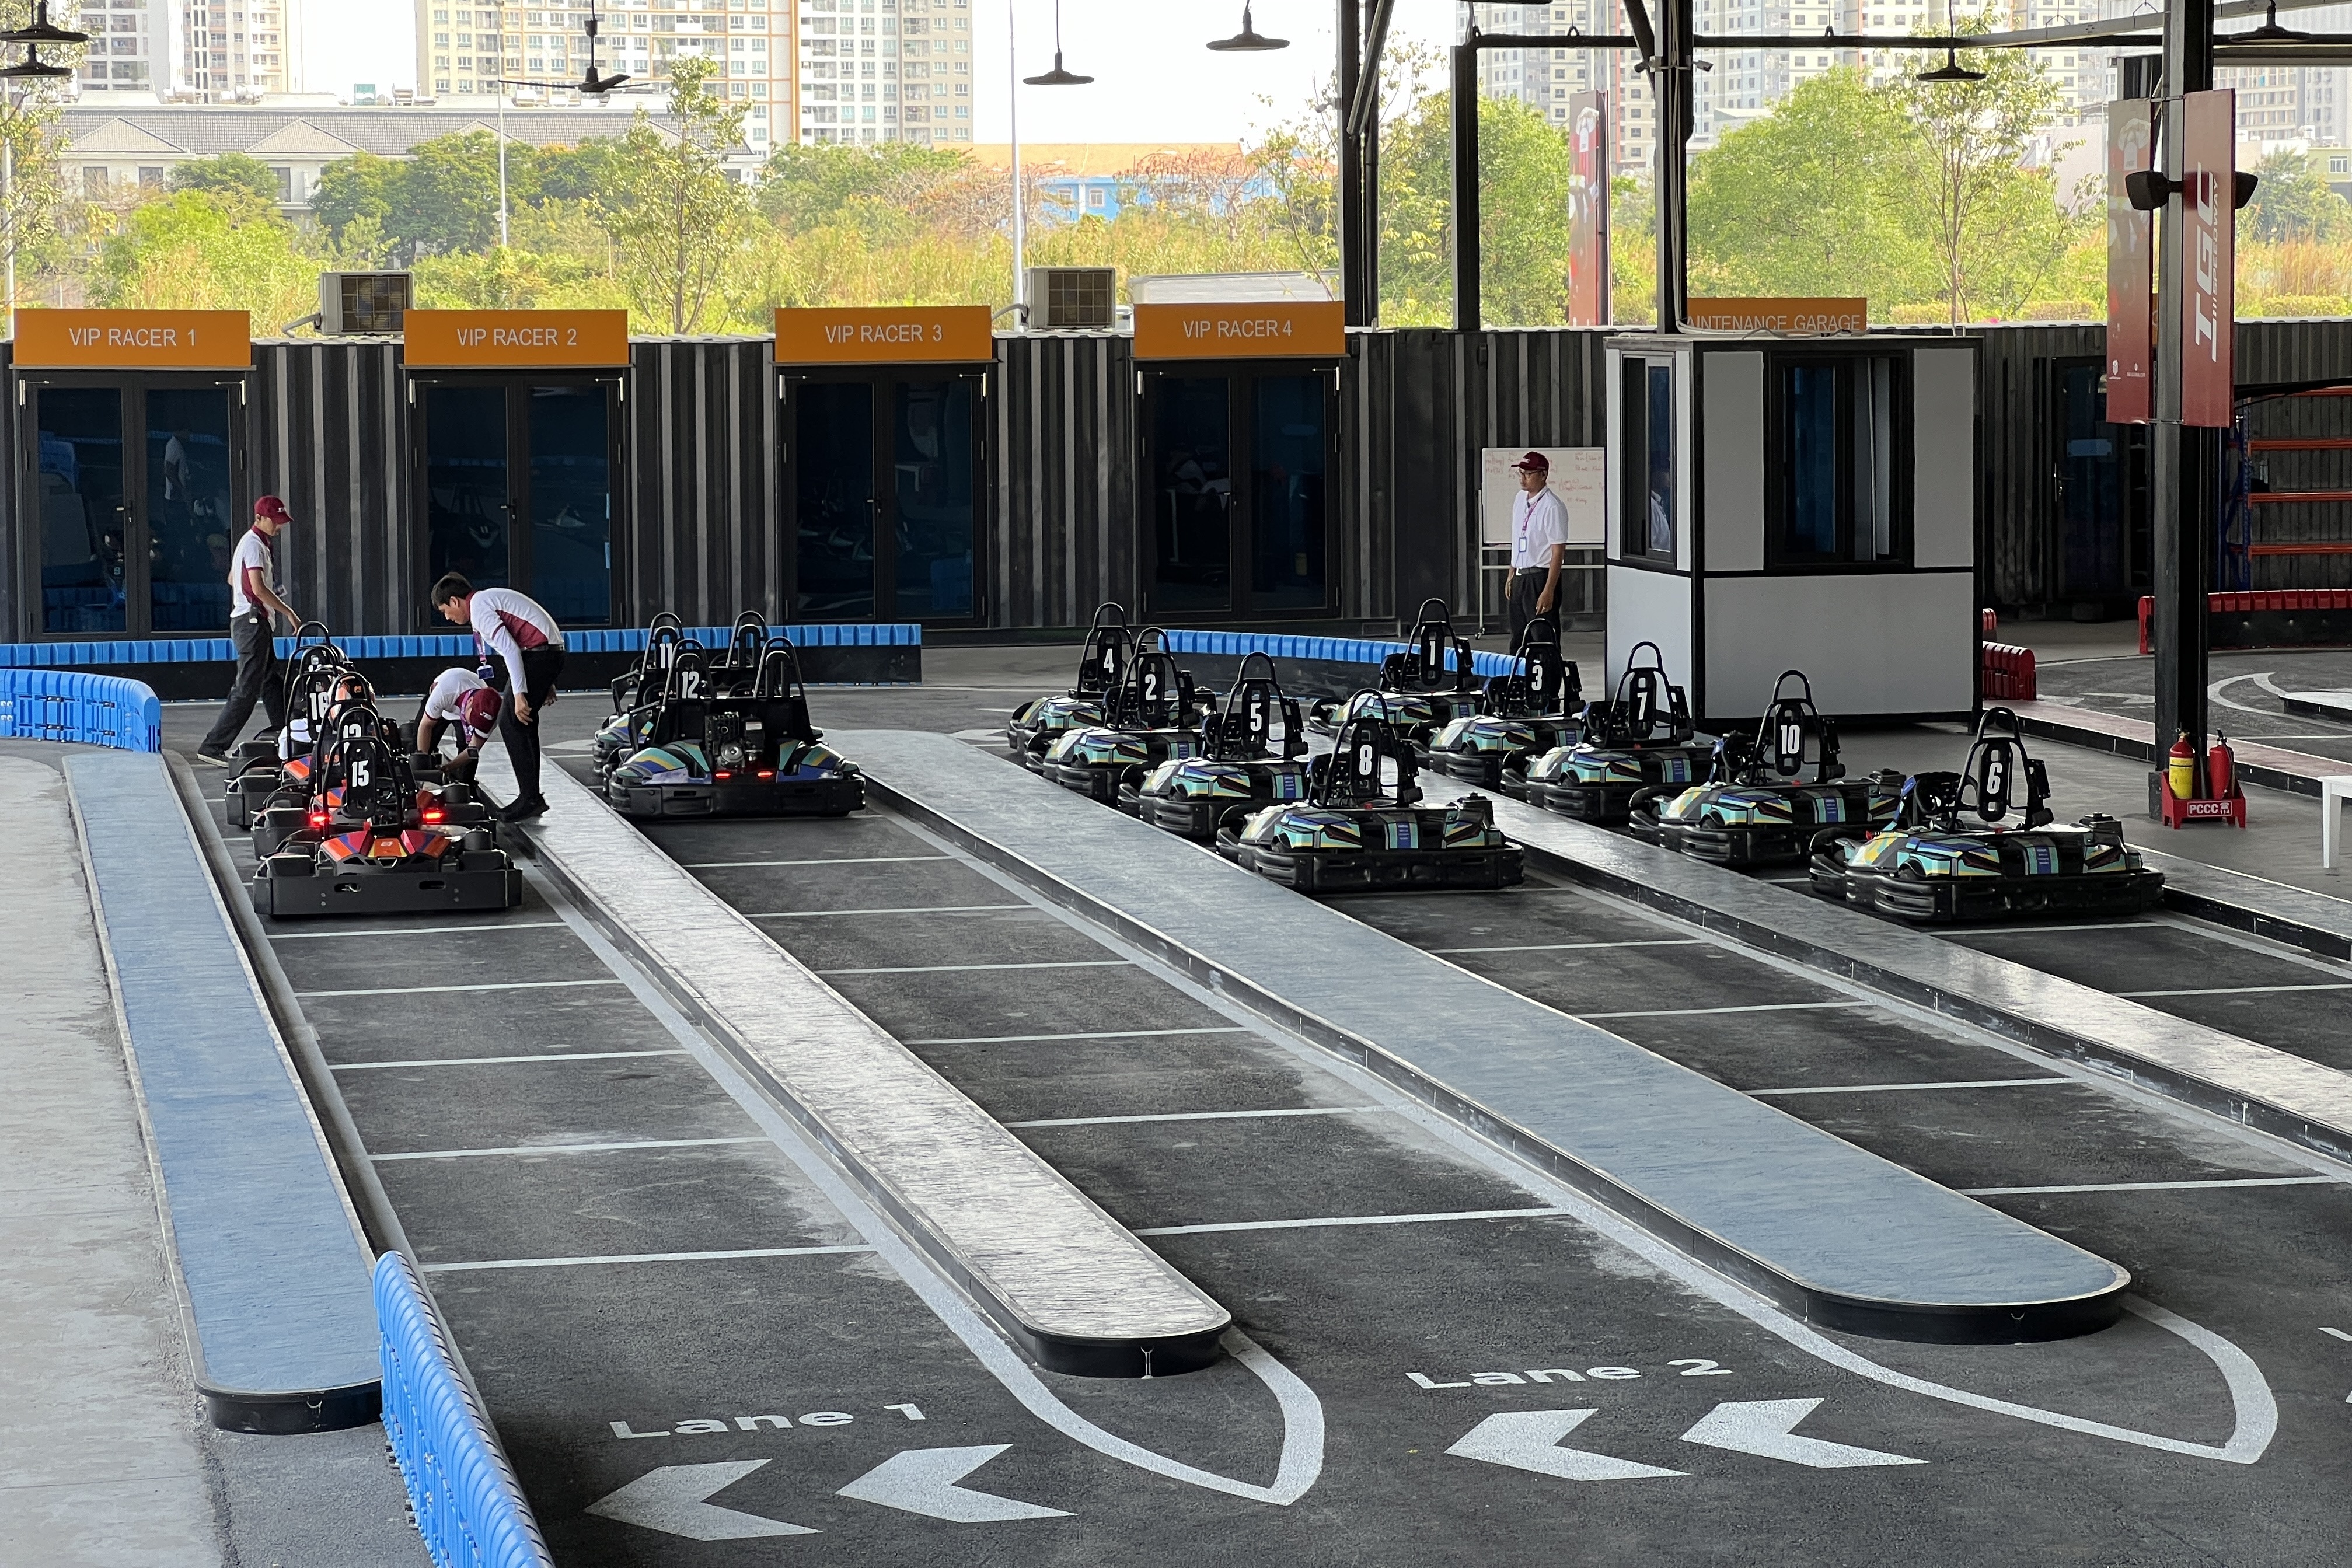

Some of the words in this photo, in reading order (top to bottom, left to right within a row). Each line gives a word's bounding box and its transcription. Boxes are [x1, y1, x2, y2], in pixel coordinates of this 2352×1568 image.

[825, 325, 853, 343] VIP
[861, 324, 923, 342] RACER
[933, 324, 942, 341] 3
[1183, 320, 1211, 338] VIP
[1217, 320, 1278, 337] RACER
[1282, 320, 1292, 336] 4
[1687, 315, 1788, 330] AINTENANCE
[1794, 314, 1861, 331] GARAGE
[69, 327, 100, 346] VIP
[109, 328, 177, 346] RACER
[187, 328, 195, 346] 1
[457, 328, 486, 345] VIP
[494, 328, 558, 345] RACER
[567, 328, 577, 345] 2
[659, 642, 672, 669] 11
[1104, 648, 1114, 673] 4
[1429, 641, 1436, 665] 1
[682, 671, 699, 699] 12
[1144, 673, 1157, 701] 2
[1531, 665, 1543, 691] 3
[1250, 703, 1262, 731] 5
[1637, 692, 1648, 720] 7
[1780, 724, 1800, 755] 10
[351, 760, 369, 787] 15
[1359, 745, 1373, 776] 8
[1987, 762, 2002, 794] 6
[2189, 804, 2218, 815] PCCC
[1405, 1366, 1642, 1390] Lane
[1666, 1358, 1733, 1377] 2
[609, 1410, 854, 1440] Lane
[883, 1403, 926, 1421] 1
